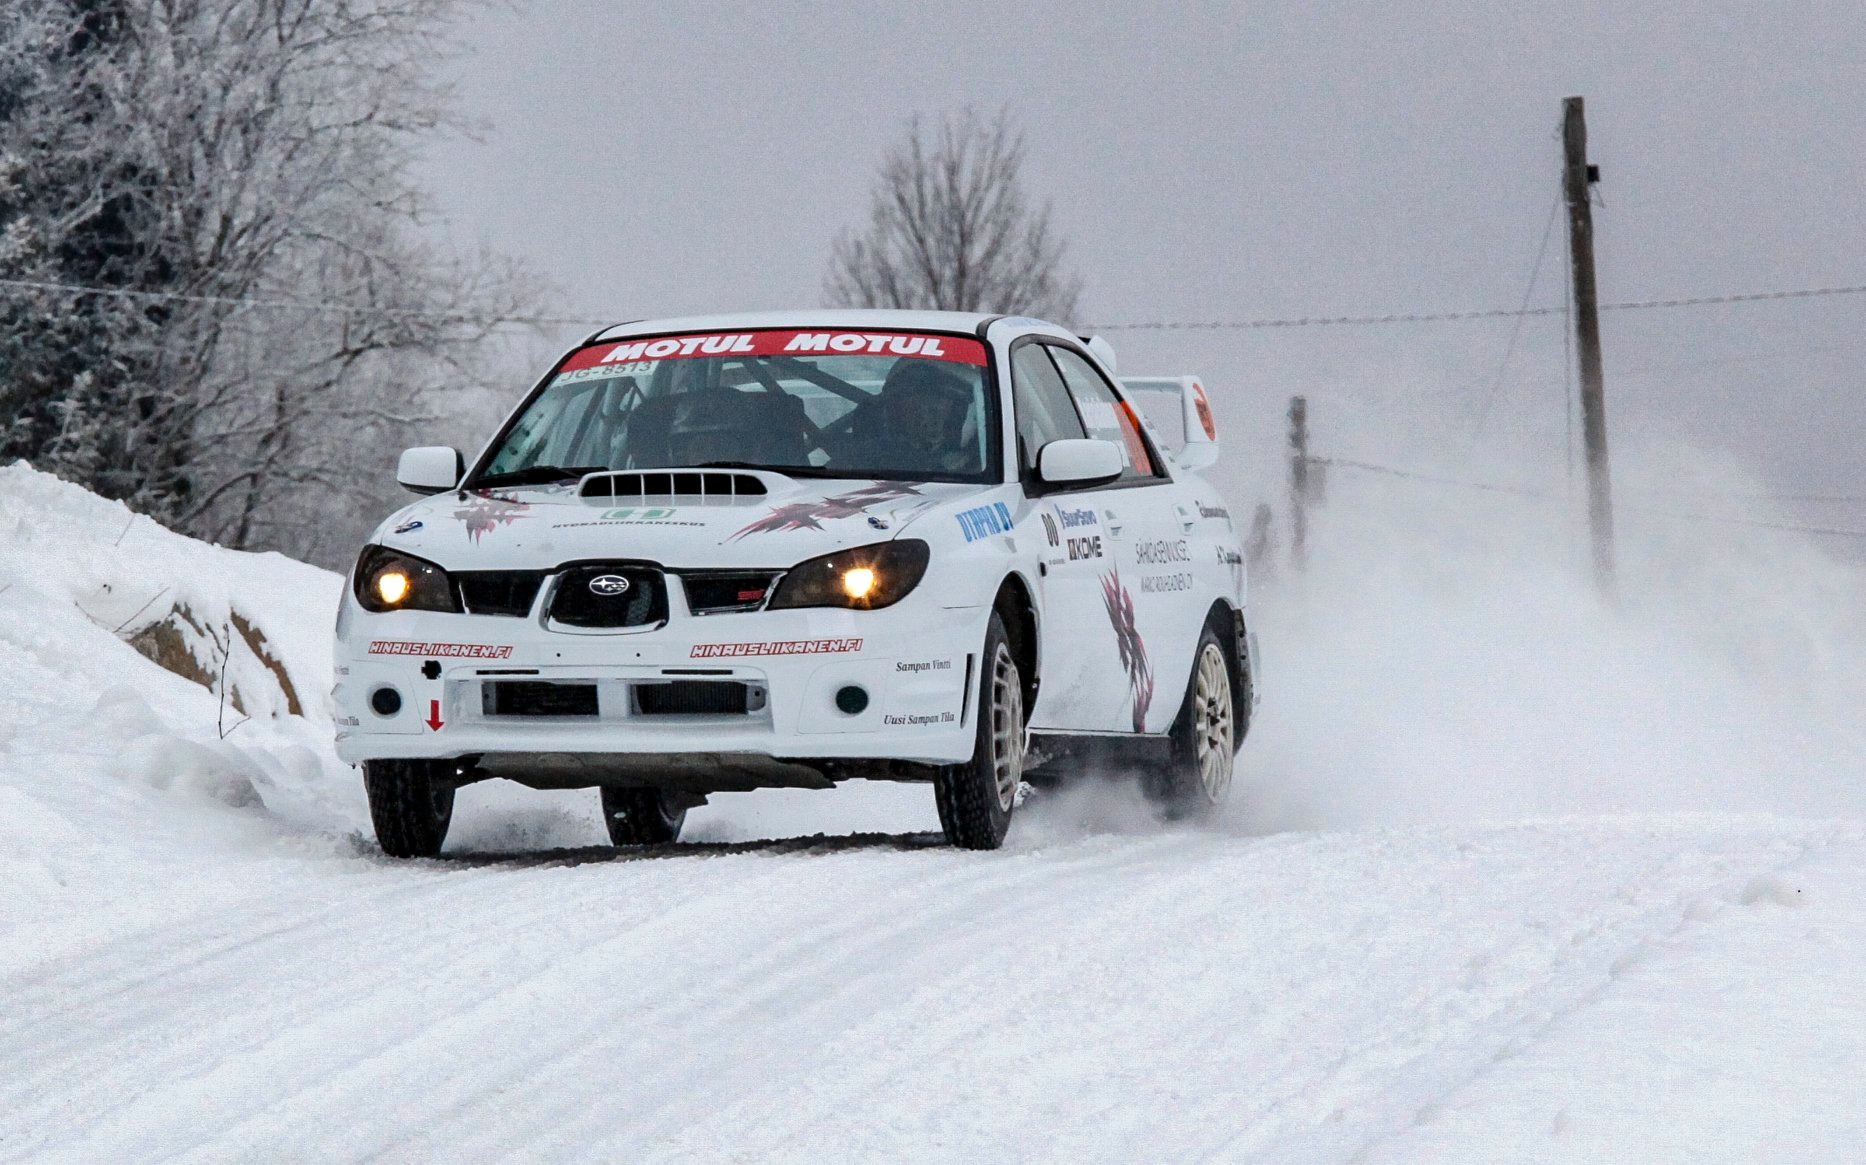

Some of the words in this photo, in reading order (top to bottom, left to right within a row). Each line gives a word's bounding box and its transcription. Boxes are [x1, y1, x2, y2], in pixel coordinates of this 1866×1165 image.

[600, 334, 756, 364] MOTUL
[783, 333, 945, 357] MOTUL
[368, 641, 513, 659] HINAUSLIIKANEN.FI
[690, 638, 864, 658] HINAUSLIIKANEN.FI
[896, 661, 931, 674] Sampan
[884, 714, 907, 725] Uusi
[907, 714, 939, 727] Sampan
